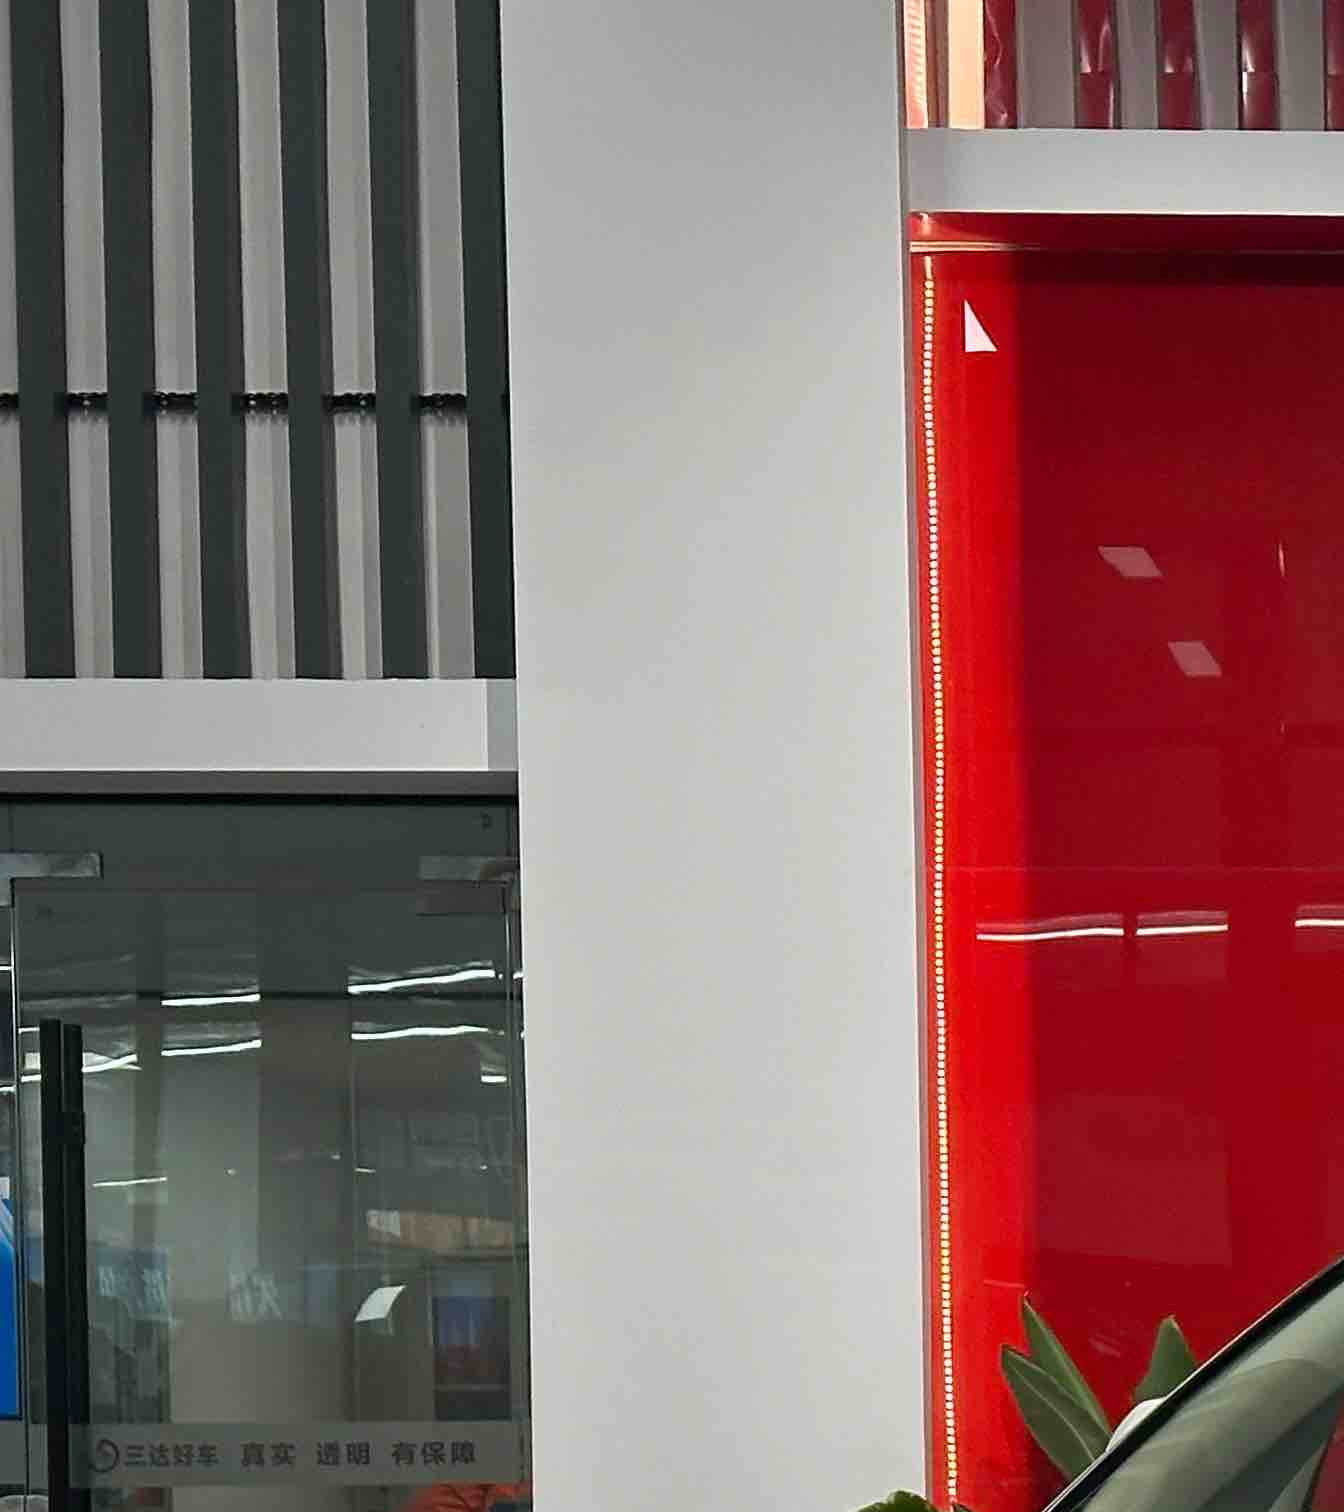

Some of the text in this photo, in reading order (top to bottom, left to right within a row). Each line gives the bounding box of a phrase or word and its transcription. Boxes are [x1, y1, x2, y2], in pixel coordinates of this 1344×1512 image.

[123, 1441, 478, 1468] 三达好车 真实 透明 有保障
